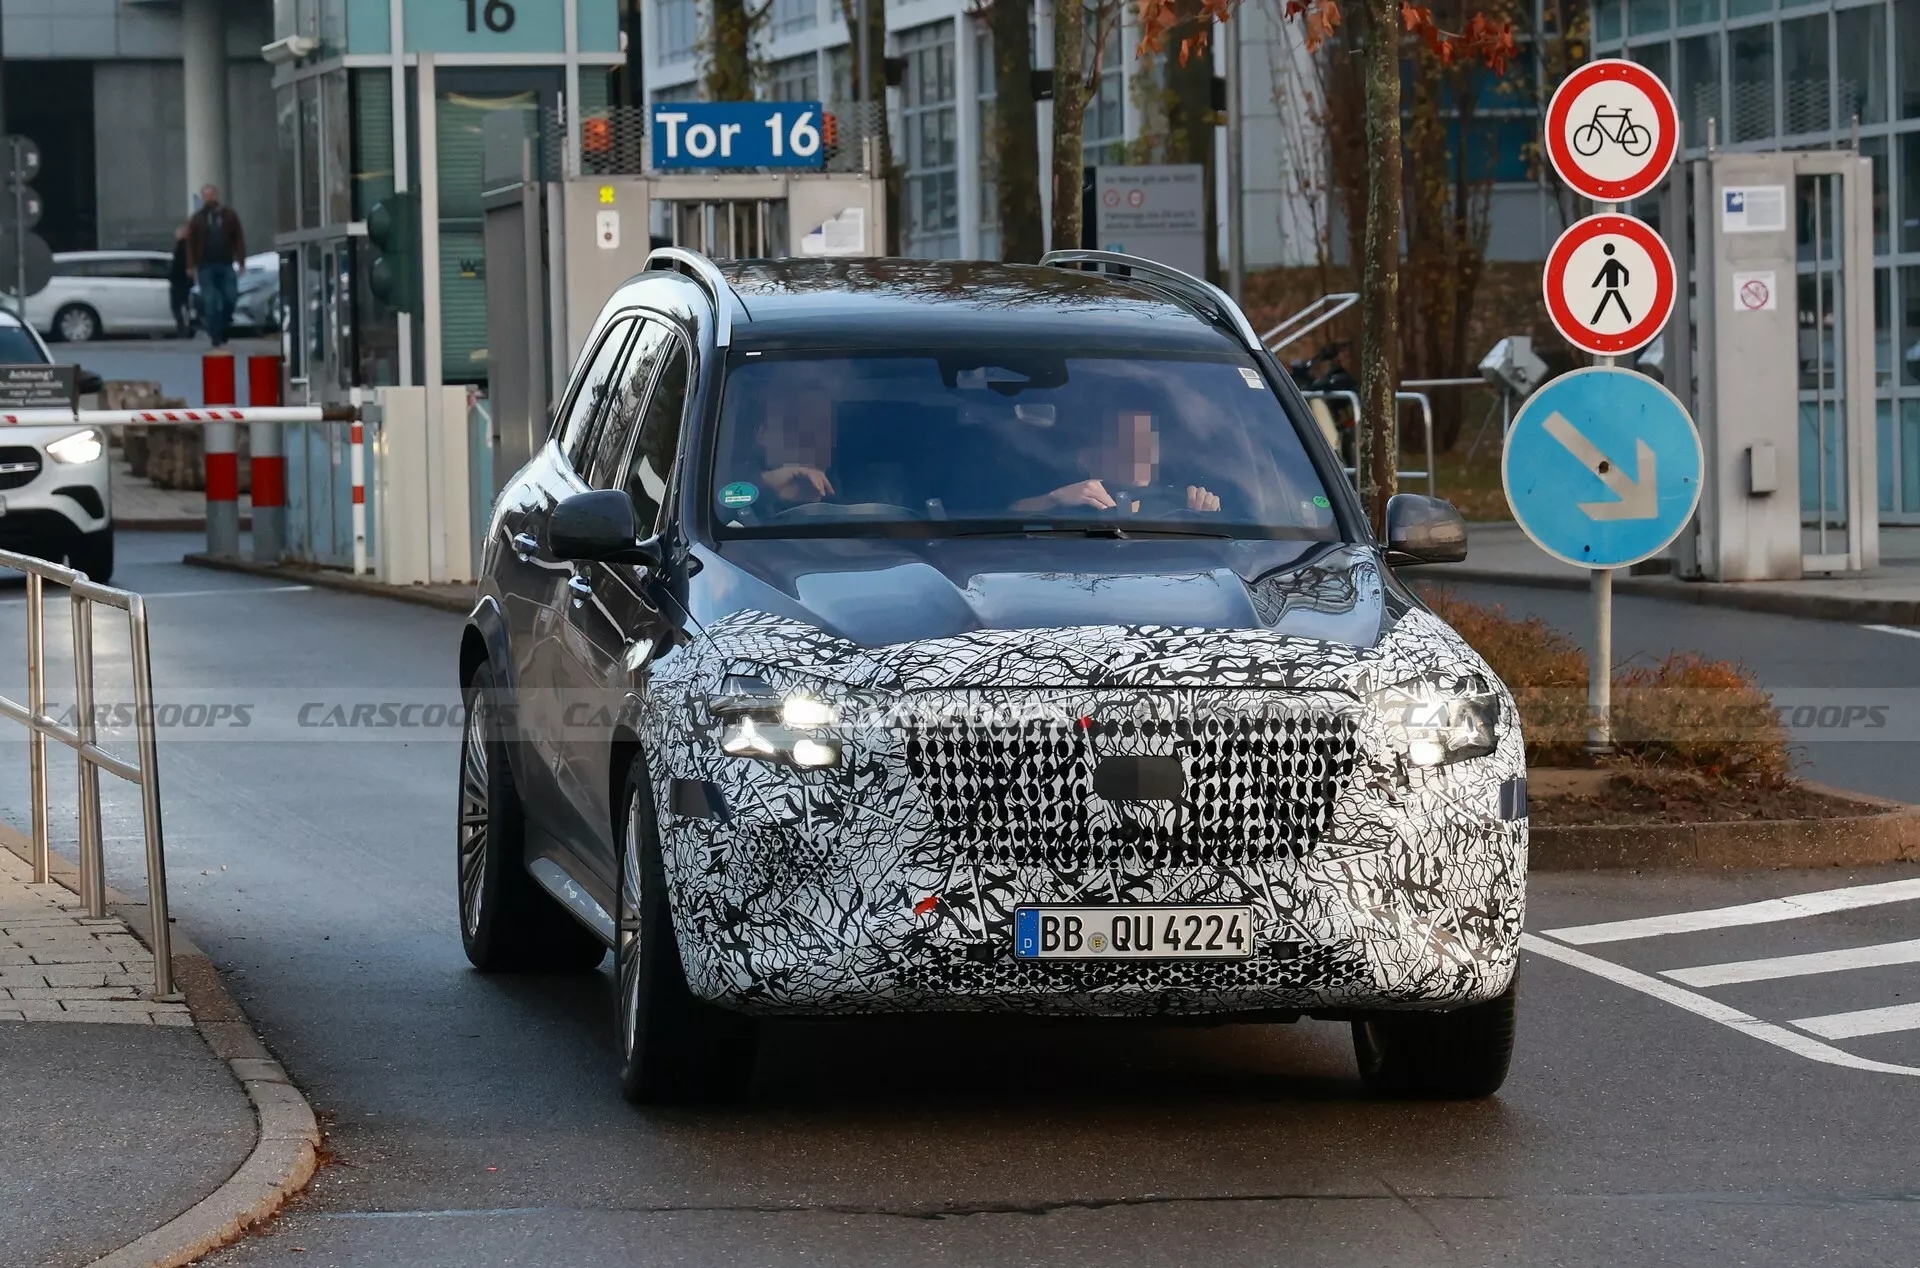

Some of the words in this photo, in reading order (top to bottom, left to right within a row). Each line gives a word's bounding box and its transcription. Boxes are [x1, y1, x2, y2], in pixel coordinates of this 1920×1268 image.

[460, 0, 515, 33] 16
[655, 112, 741, 158] Tor
[764, 111, 820, 157] 16
[733, 485, 743, 496] 4
[1024, 938, 1032, 949] D
[1041, 915, 1083, 951] BB
[1112, 915, 1154, 951] QU
[1163, 914, 1245, 951] 4224
